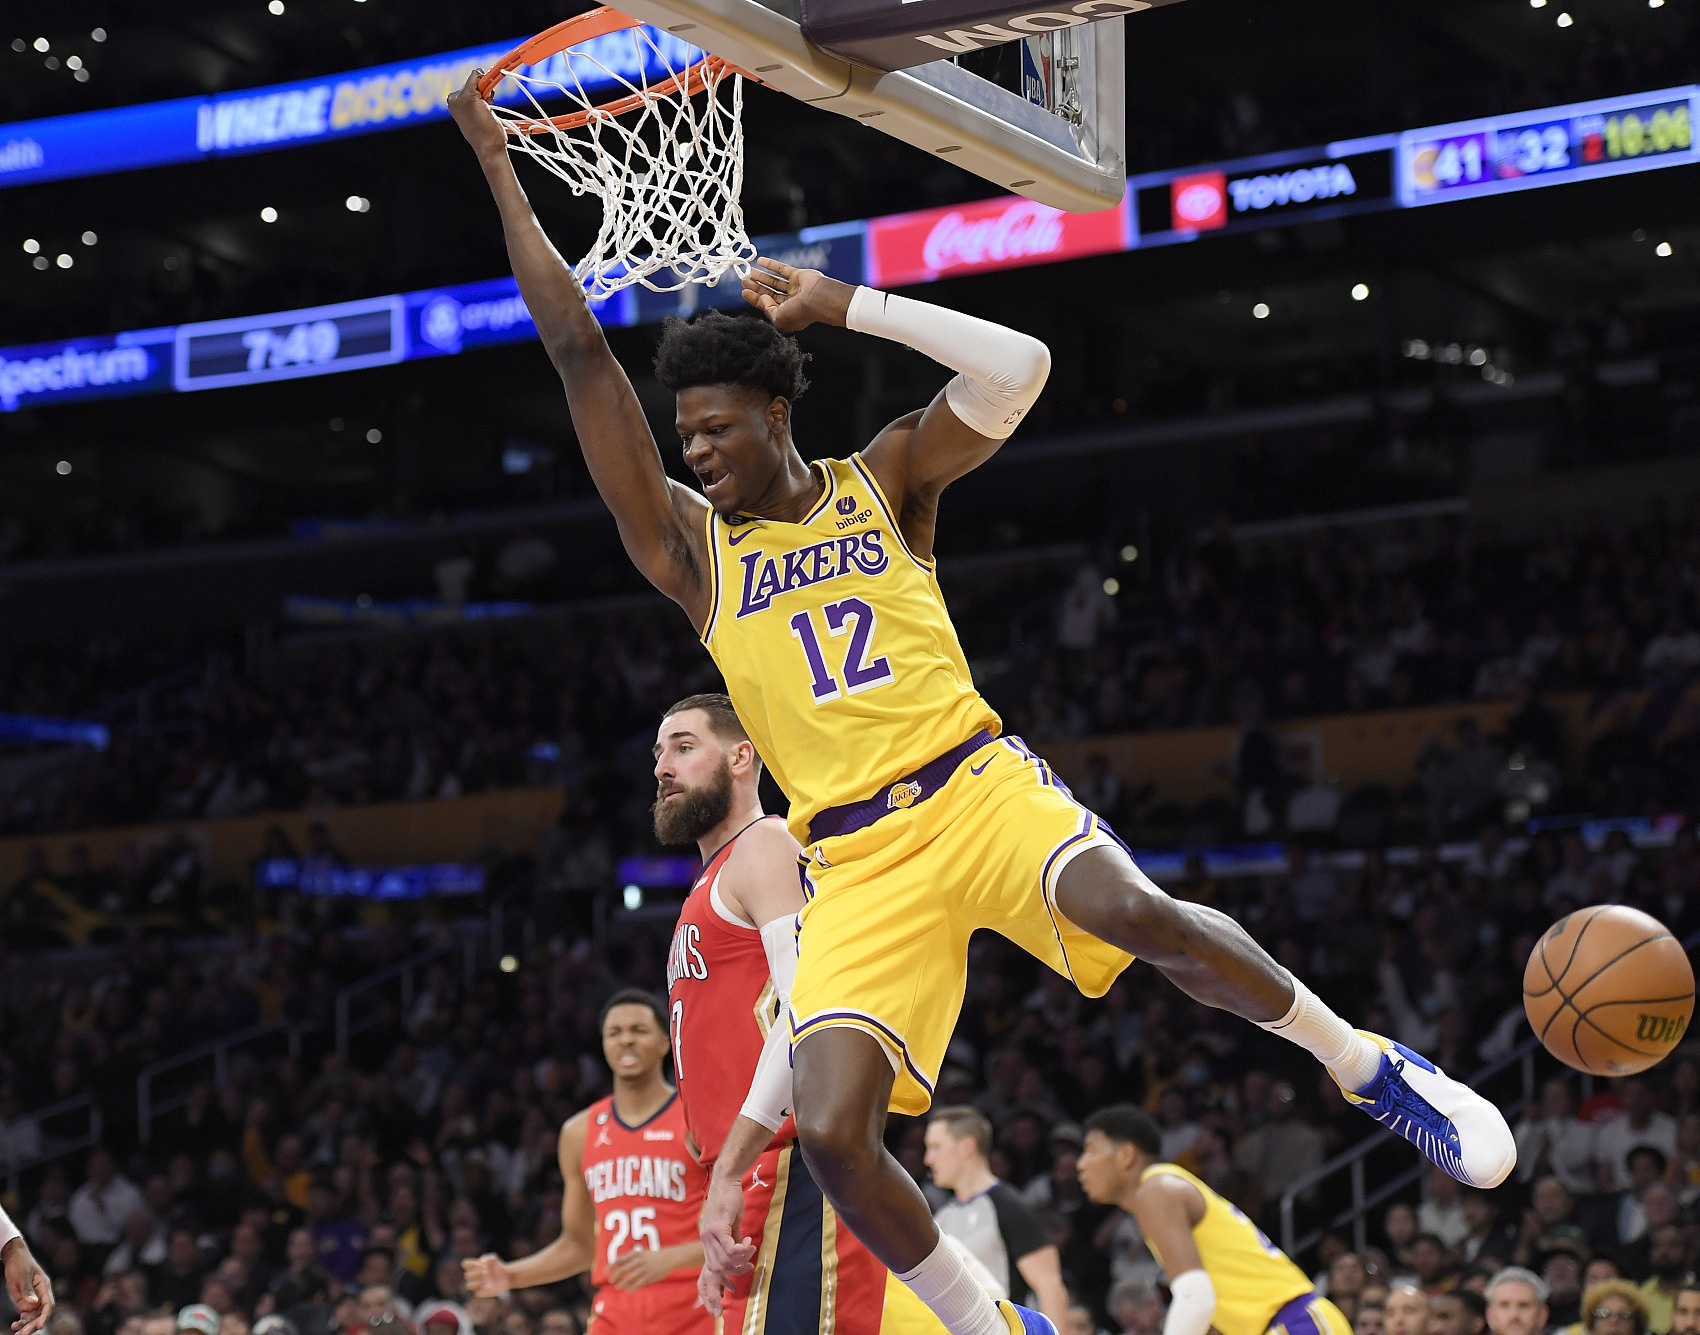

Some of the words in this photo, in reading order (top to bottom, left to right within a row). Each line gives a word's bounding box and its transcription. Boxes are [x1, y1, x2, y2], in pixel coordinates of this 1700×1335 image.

[196, 84, 333, 152] WHERE
[329, 55, 520, 130] DISCOV
[1025, 74, 1041, 101] NBA
[1433, 141, 1484, 186] 41
[1515, 124, 1570, 173] 32
[1228, 163, 1357, 212] TOYOTA
[242, 320, 340, 372] 7:49
[0, 346, 149, 412] pectrum
[835, 509, 873, 530] bibigo
[736, 529, 889, 621] LAKERS
[788, 595, 896, 706] 12
[887, 784, 922, 809] LAKERS
[584, 1154, 687, 1204] PELICANS
[603, 1206, 661, 1266] 25
